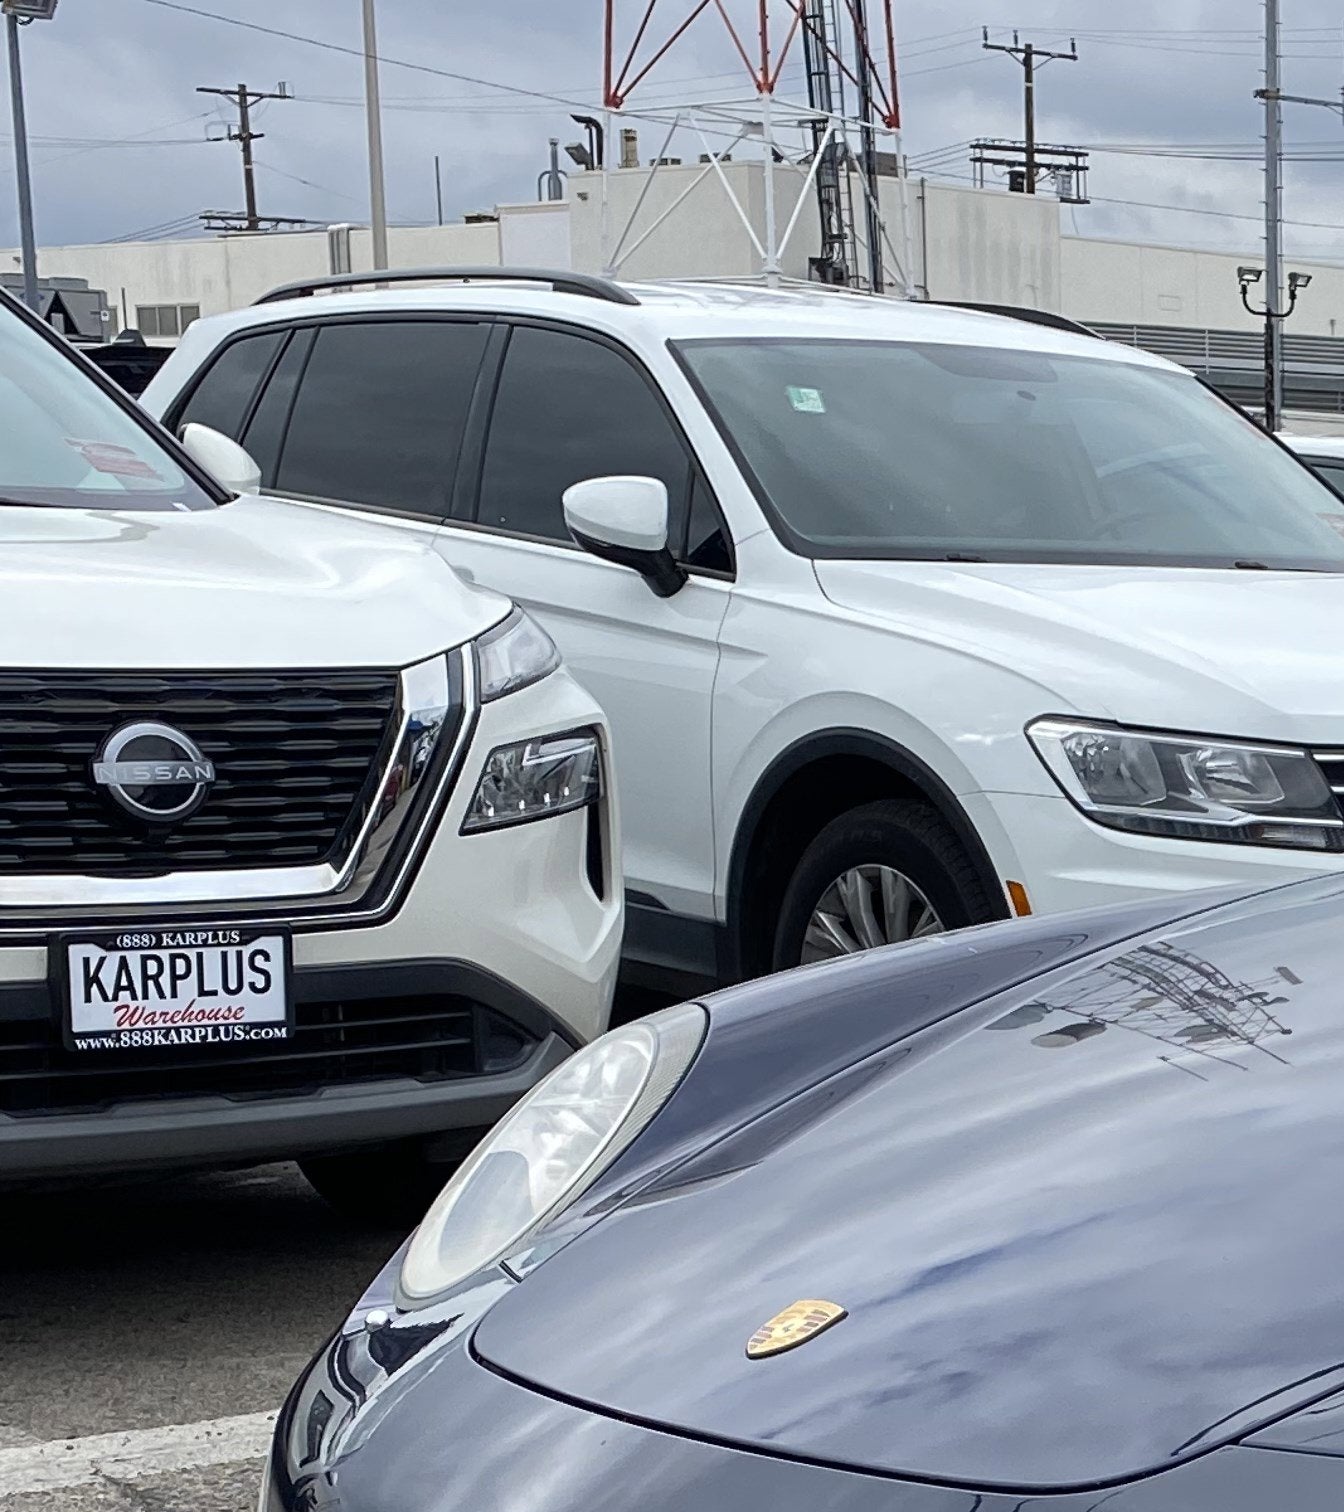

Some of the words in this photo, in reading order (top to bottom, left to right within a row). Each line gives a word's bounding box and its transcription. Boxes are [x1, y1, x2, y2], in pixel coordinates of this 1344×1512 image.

[99, 764, 212, 780] NISSAN
[116, 933, 156, 948] (888)
[161, 930, 240, 947] KARPLUS
[82, 949, 272, 1004] KARPLUS
[113, 998, 245, 1028] Warehouse
